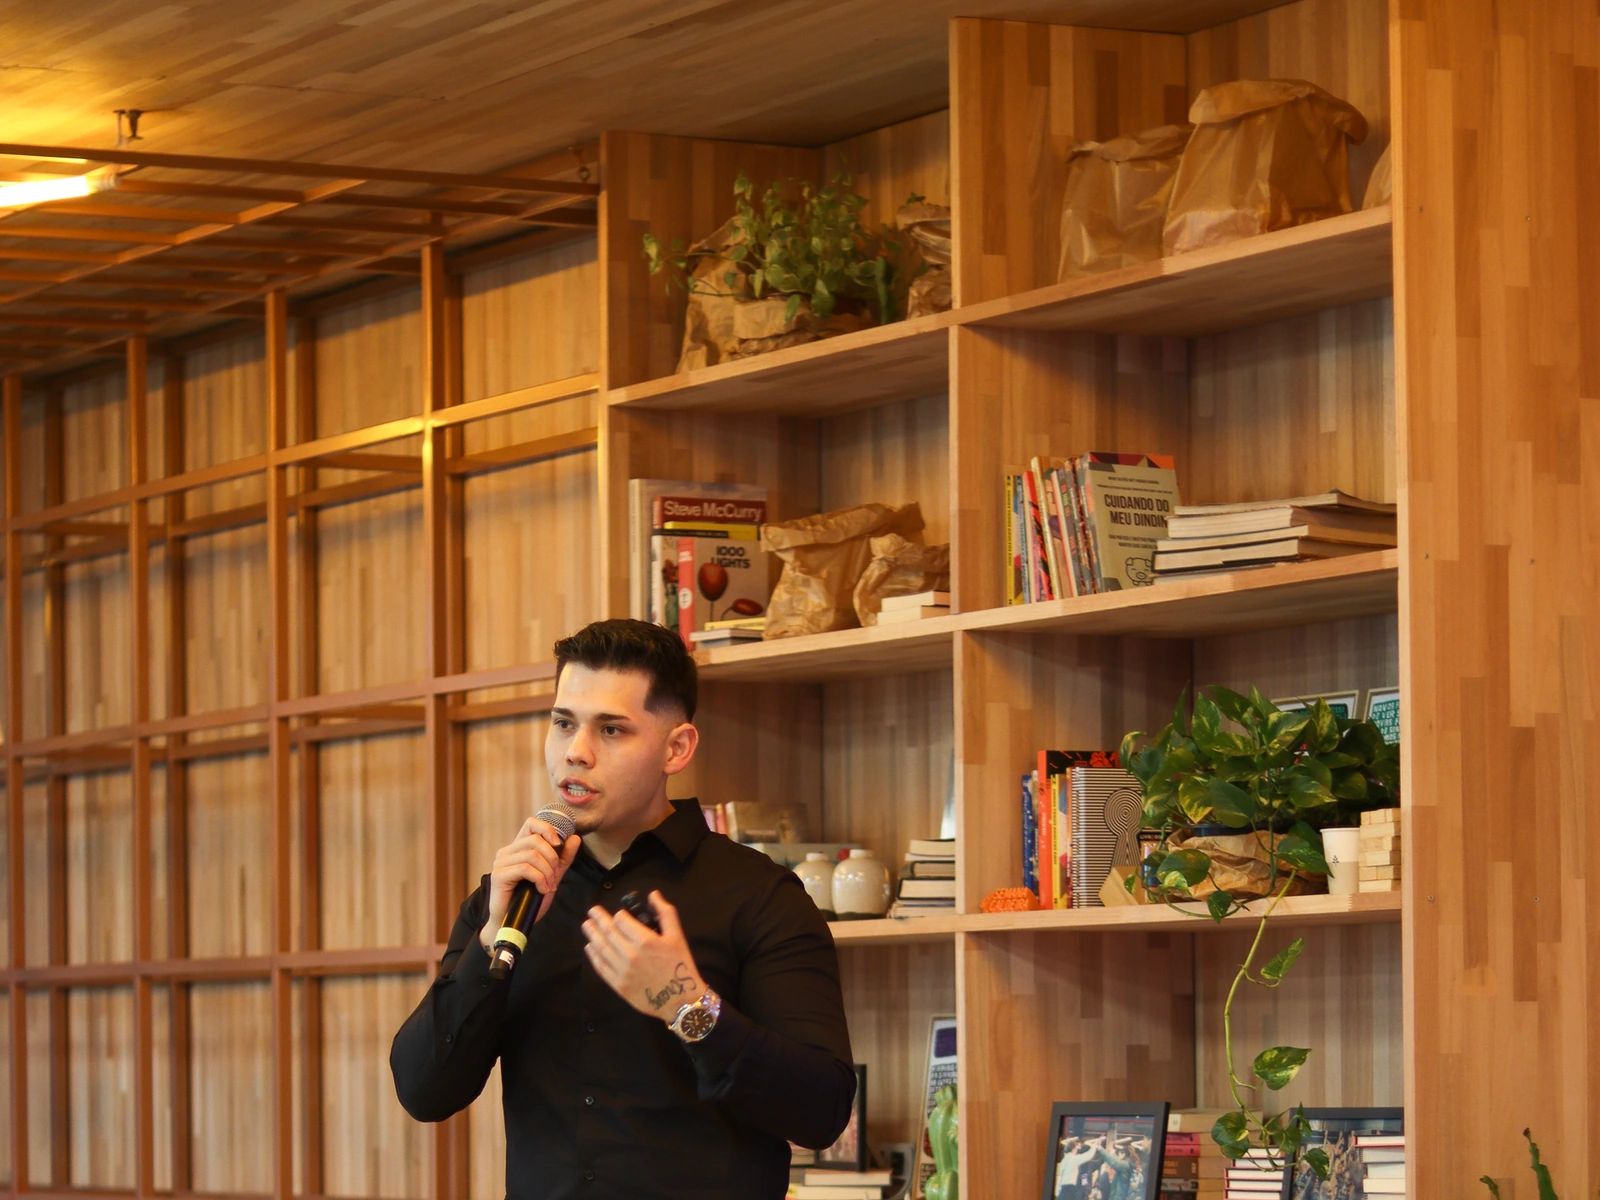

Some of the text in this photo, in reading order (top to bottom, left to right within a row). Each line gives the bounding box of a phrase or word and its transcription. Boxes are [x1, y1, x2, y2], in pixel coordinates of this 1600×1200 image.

[663, 500, 701, 517] Steve
[703, 502, 762, 522] McCurry
[1104, 494, 1153, 511] CUIDANDO
[1155, 498, 1170, 513] DO
[1109, 510, 1132, 526] MEU
[716, 546, 746, 557] 1000
[1375, 718, 1393, 728] OVAS
